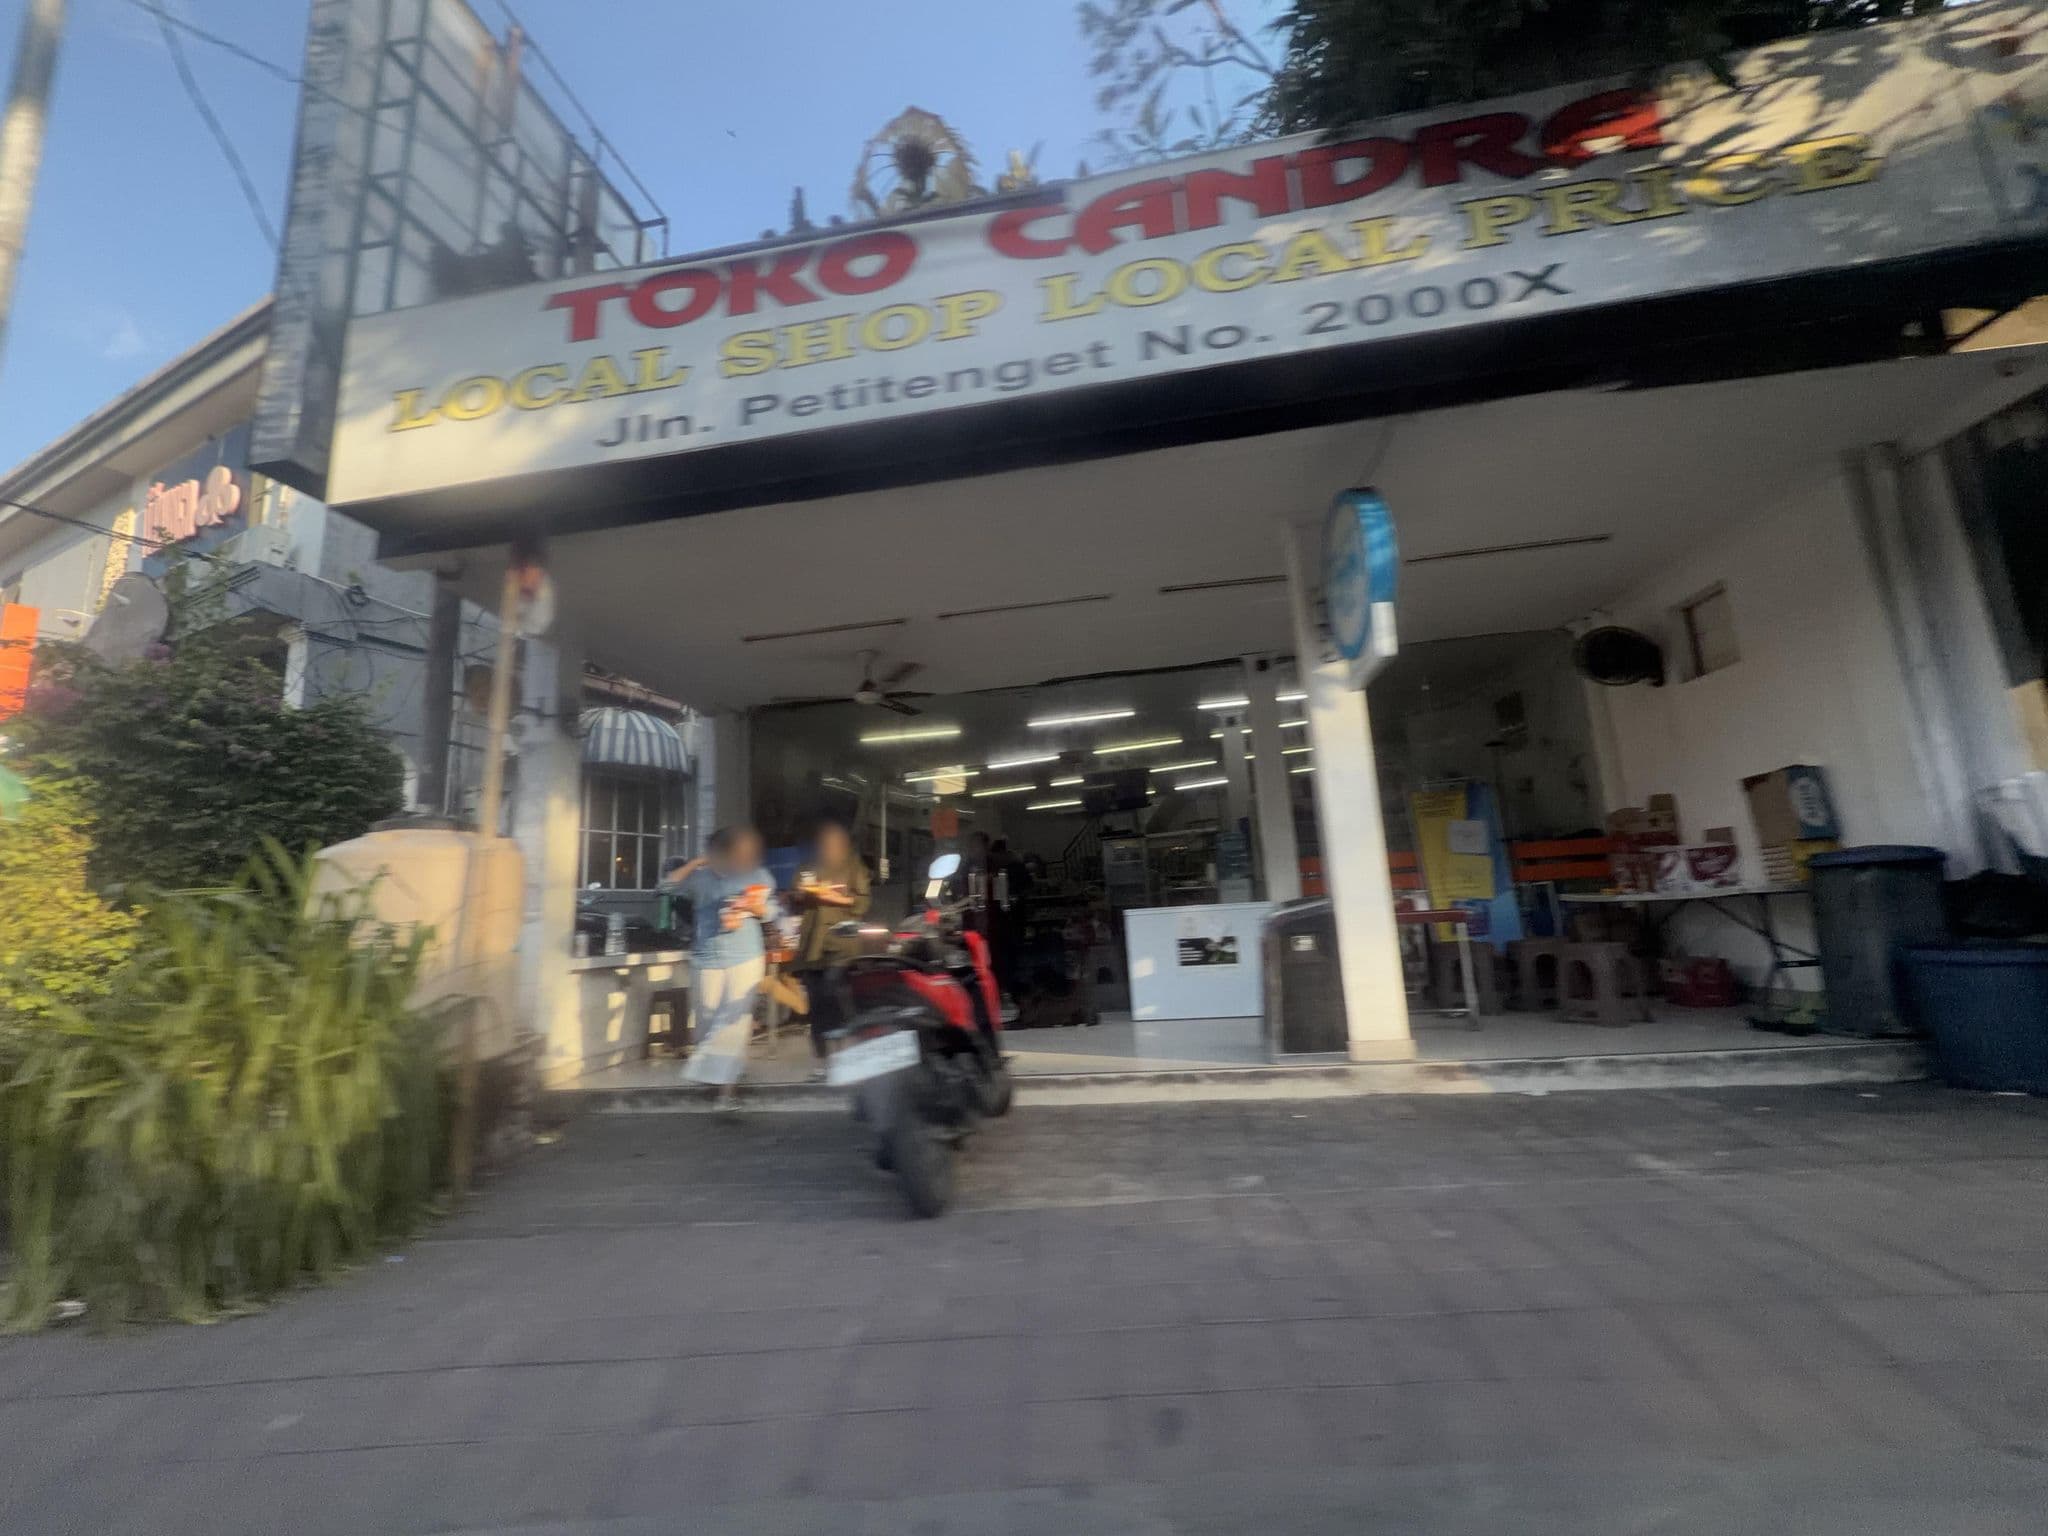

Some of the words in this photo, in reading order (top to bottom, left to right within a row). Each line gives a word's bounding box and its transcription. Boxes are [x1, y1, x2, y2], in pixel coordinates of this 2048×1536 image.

[389, 346, 691, 433] LOCAL
[718, 289, 1002, 379] SHOP
[1039, 215, 1432, 323] LOCAL
[1458, 132, 1885, 250] PRICE
[545, 232, 919, 343] TOKO
[986, 89, 1666, 259] CANDRA
[594, 414, 713, 449] Jln.
[738, 341, 1114, 426] Petitenget
[1140, 323, 1276, 360] No.
[1303, 263, 1574, 336] 2000X
